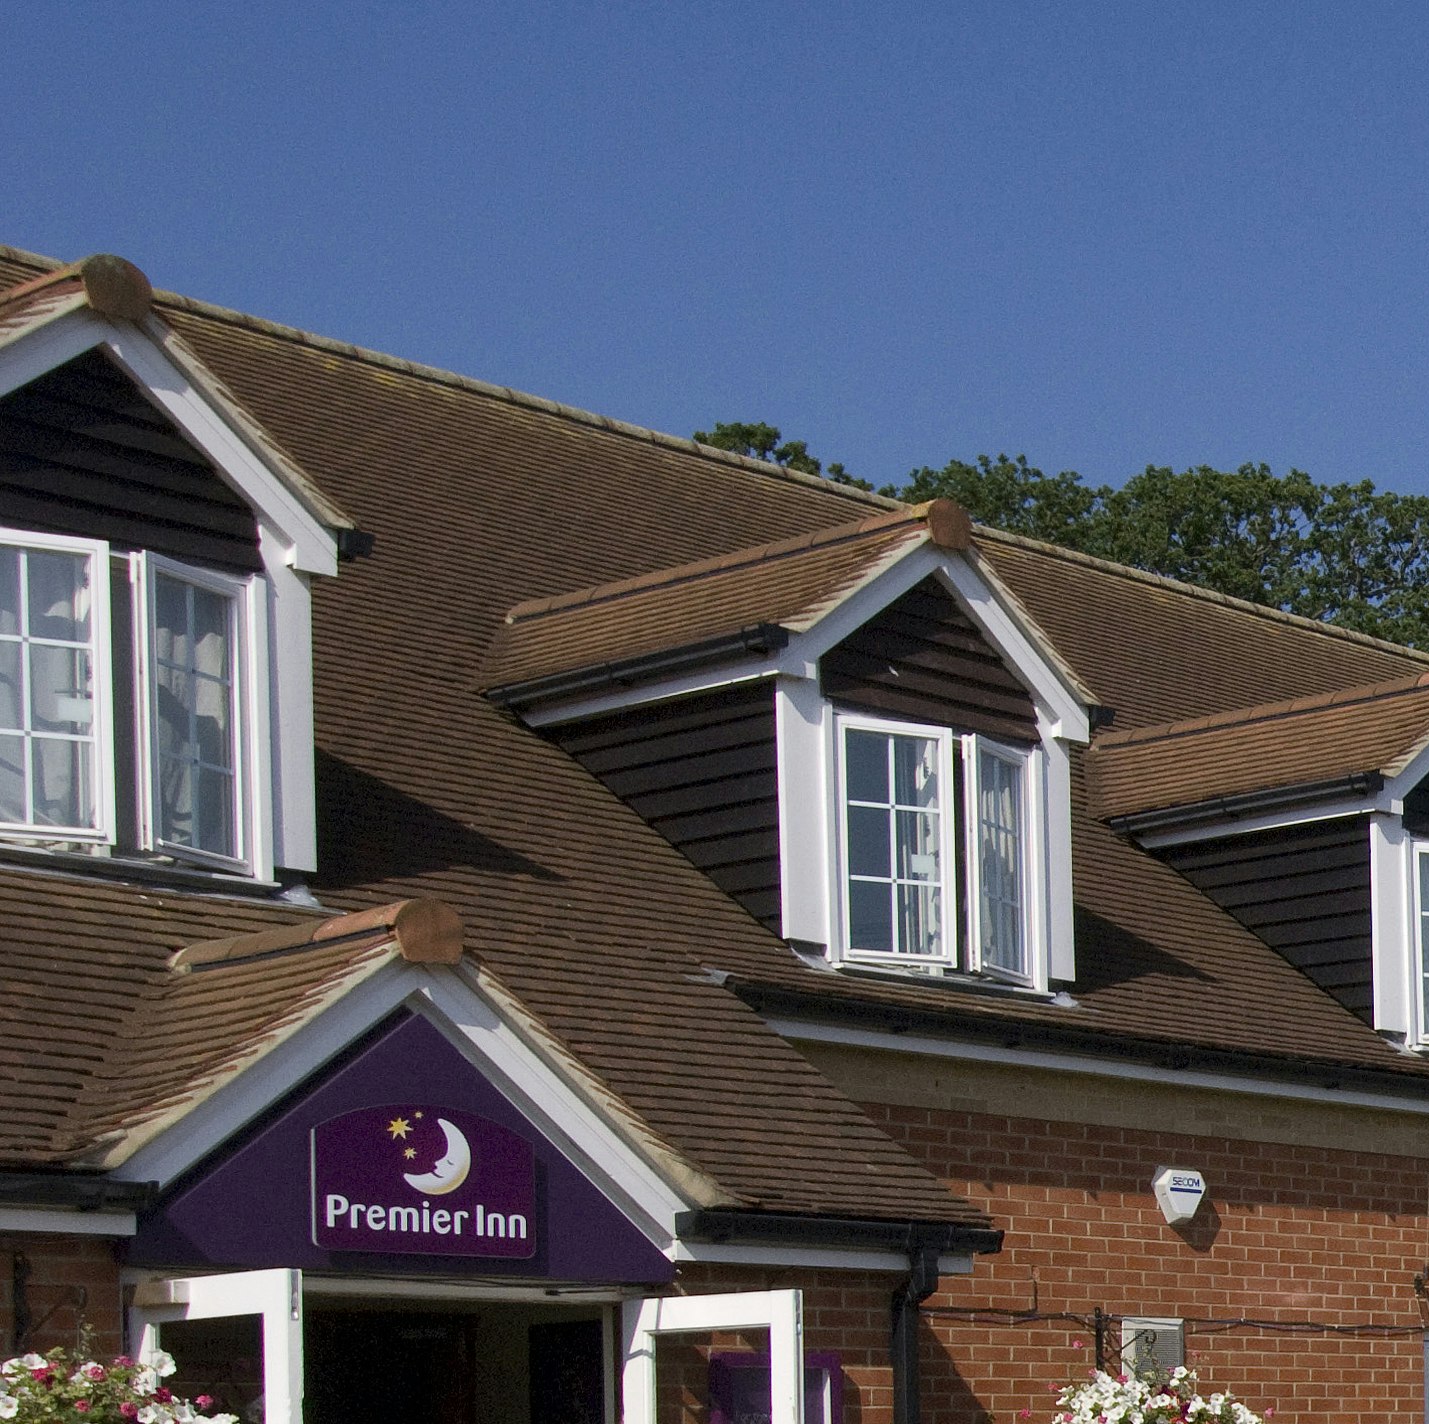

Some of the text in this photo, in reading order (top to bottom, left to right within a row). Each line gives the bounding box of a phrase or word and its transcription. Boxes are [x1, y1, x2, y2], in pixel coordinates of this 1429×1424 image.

[1172, 1176, 1200, 1187] SECOM
[326, 1194, 527, 1239] Premier Inn
